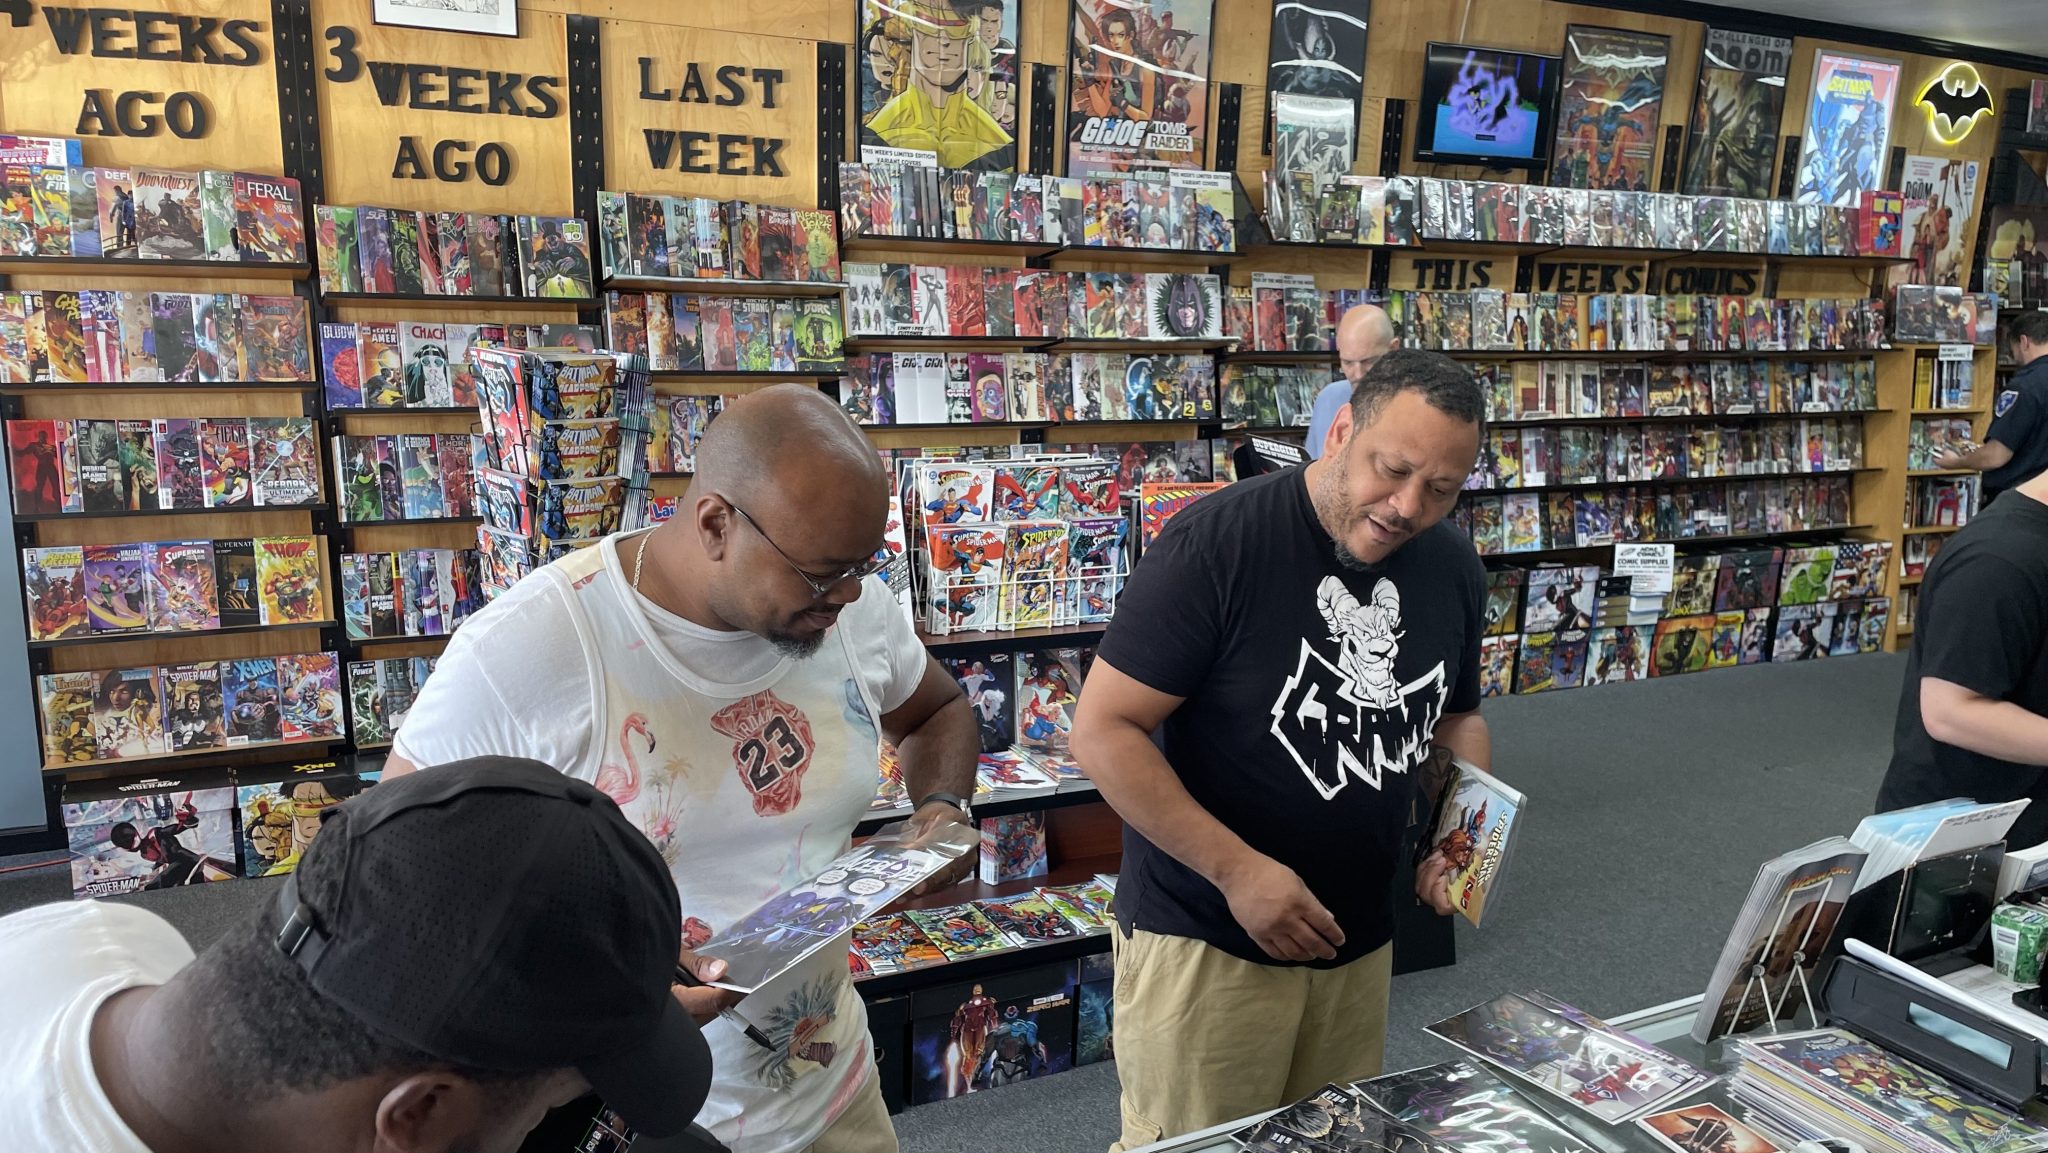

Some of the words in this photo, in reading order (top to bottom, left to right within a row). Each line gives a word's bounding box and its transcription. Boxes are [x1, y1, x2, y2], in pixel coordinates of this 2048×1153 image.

[43, 6, 259, 66] WEEKS
[325, 26, 359, 83] 3
[366, 61, 558, 118] WEEKS
[638, 57, 783, 109] LAST
[76, 89, 206, 139] AGO
[1153, 121, 1187, 135] TOMB
[643, 128, 784, 177] WEEK
[1151, 136, 1189, 149] RAIDER
[391, 136, 511, 186] AGO
[247, 181, 293, 201] FERAL
[1413, 259, 1492, 289] THIS
[1665, 267, 1759, 295] COMICS
[559, 364, 600, 383] BATMAN
[560, 427, 600, 446] BATMAN
[566, 486, 606, 503] BATMAN
[29, 555, 36, 563] 1
[165, 549, 205, 564] SUPERMAN
[171, 669, 218, 682] SPIDER-MAN
[234, 659, 277, 682] X-MEN
[738, 714, 807, 793] 23
[118, 780, 182, 793] SPIDER-MAN
[86, 877, 141, 895] SPIDER-MAN
